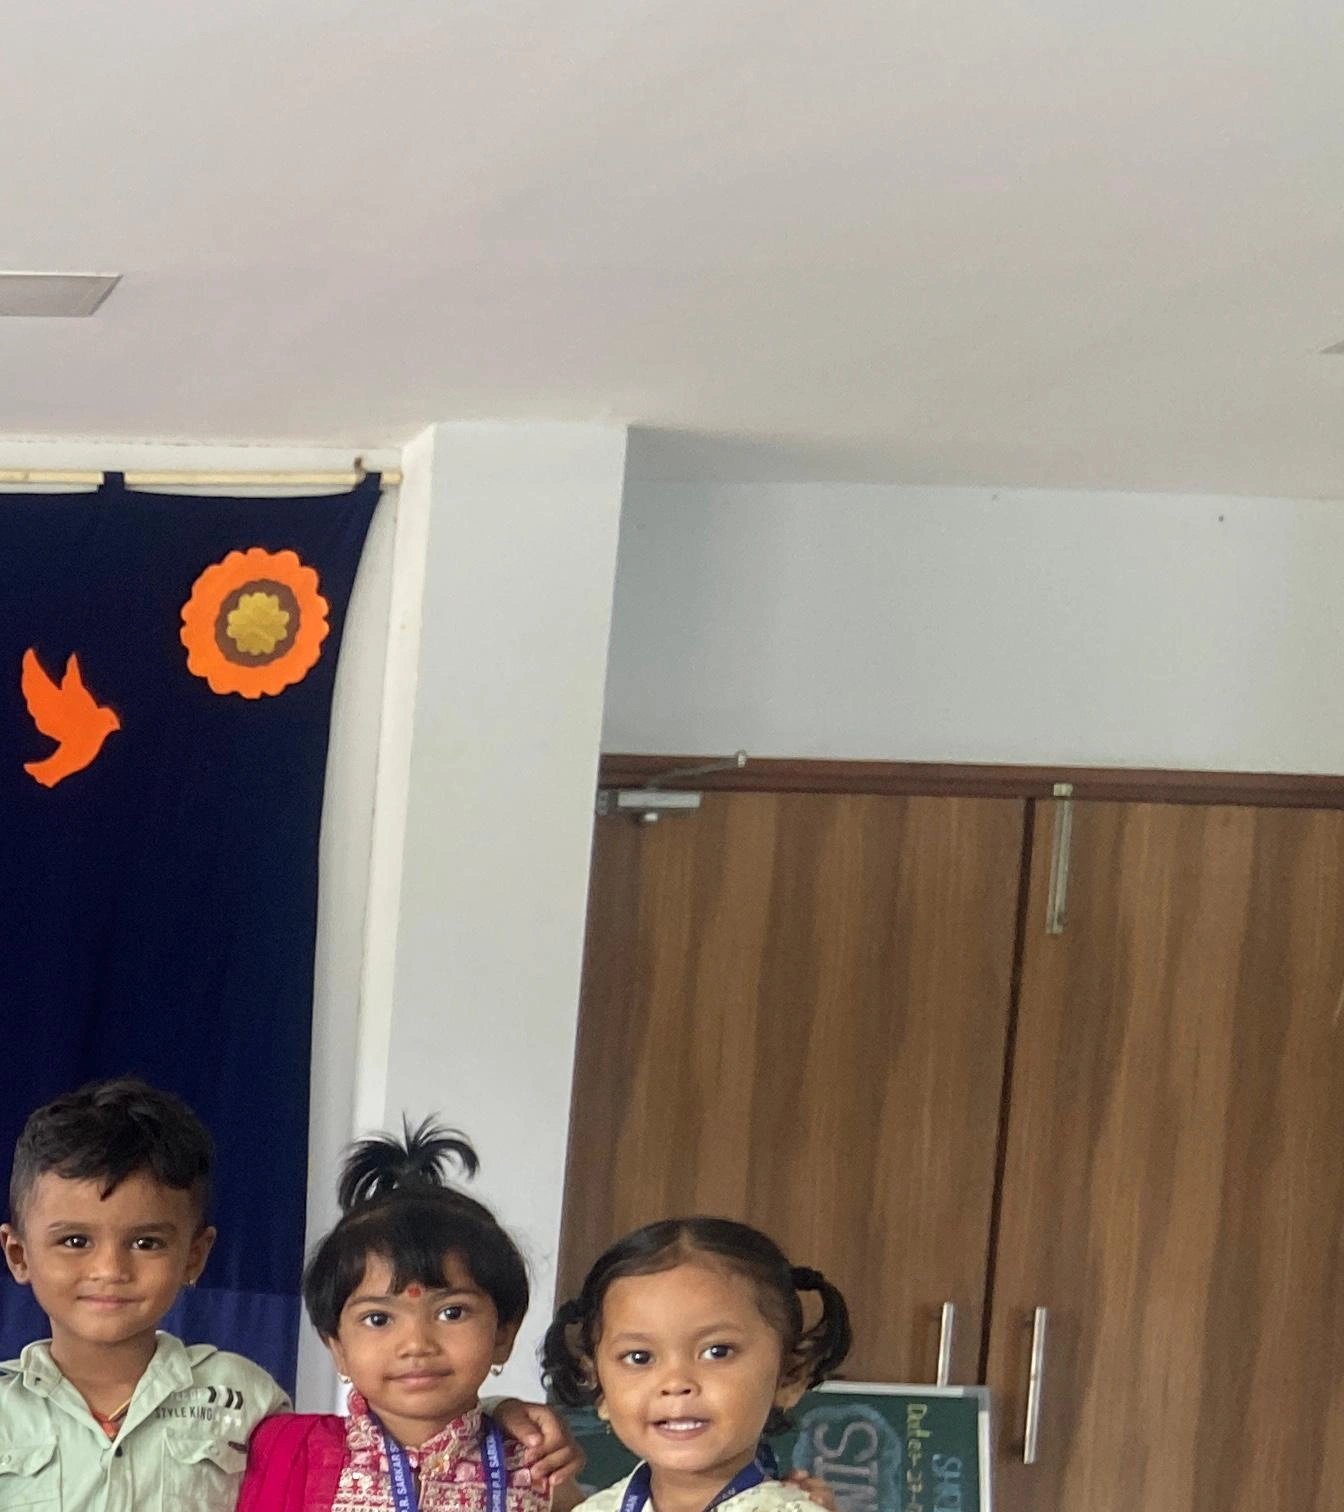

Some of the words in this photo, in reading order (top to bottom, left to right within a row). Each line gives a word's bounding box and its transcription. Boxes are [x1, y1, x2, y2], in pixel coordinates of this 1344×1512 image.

[155, 1406, 188, 1420] STYLE
[189, 1406, 213, 1421] KING
[391, 1453, 407, 1496] SARKAR
